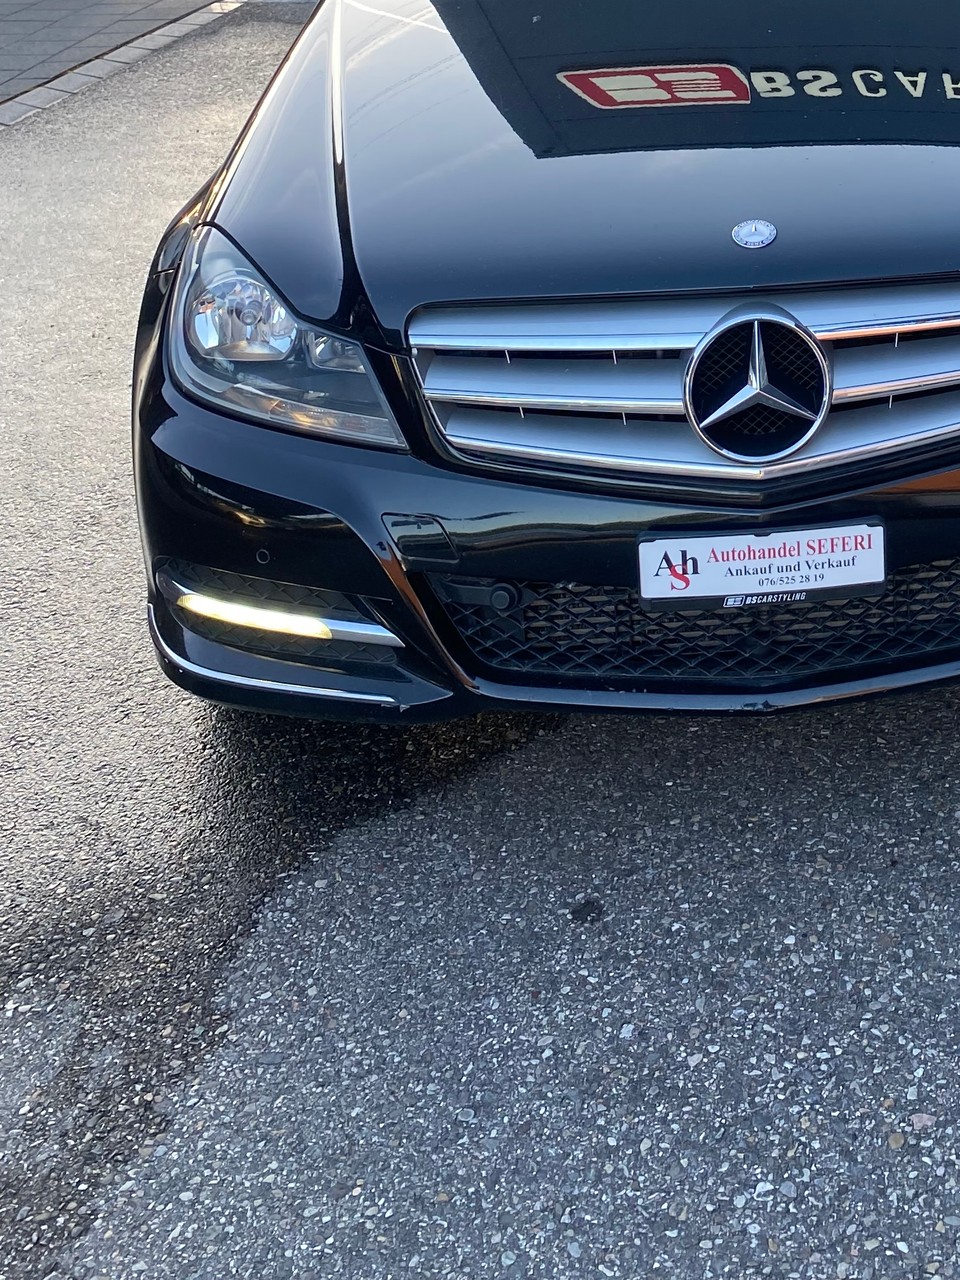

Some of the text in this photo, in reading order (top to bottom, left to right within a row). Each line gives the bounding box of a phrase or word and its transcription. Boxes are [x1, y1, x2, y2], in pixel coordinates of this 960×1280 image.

[706, 533, 873, 564] Autohandel SEFERI
[724, 555, 857, 577] Ankauf und Verkauf
[758, 573, 825, 587] 076/525 28 19
